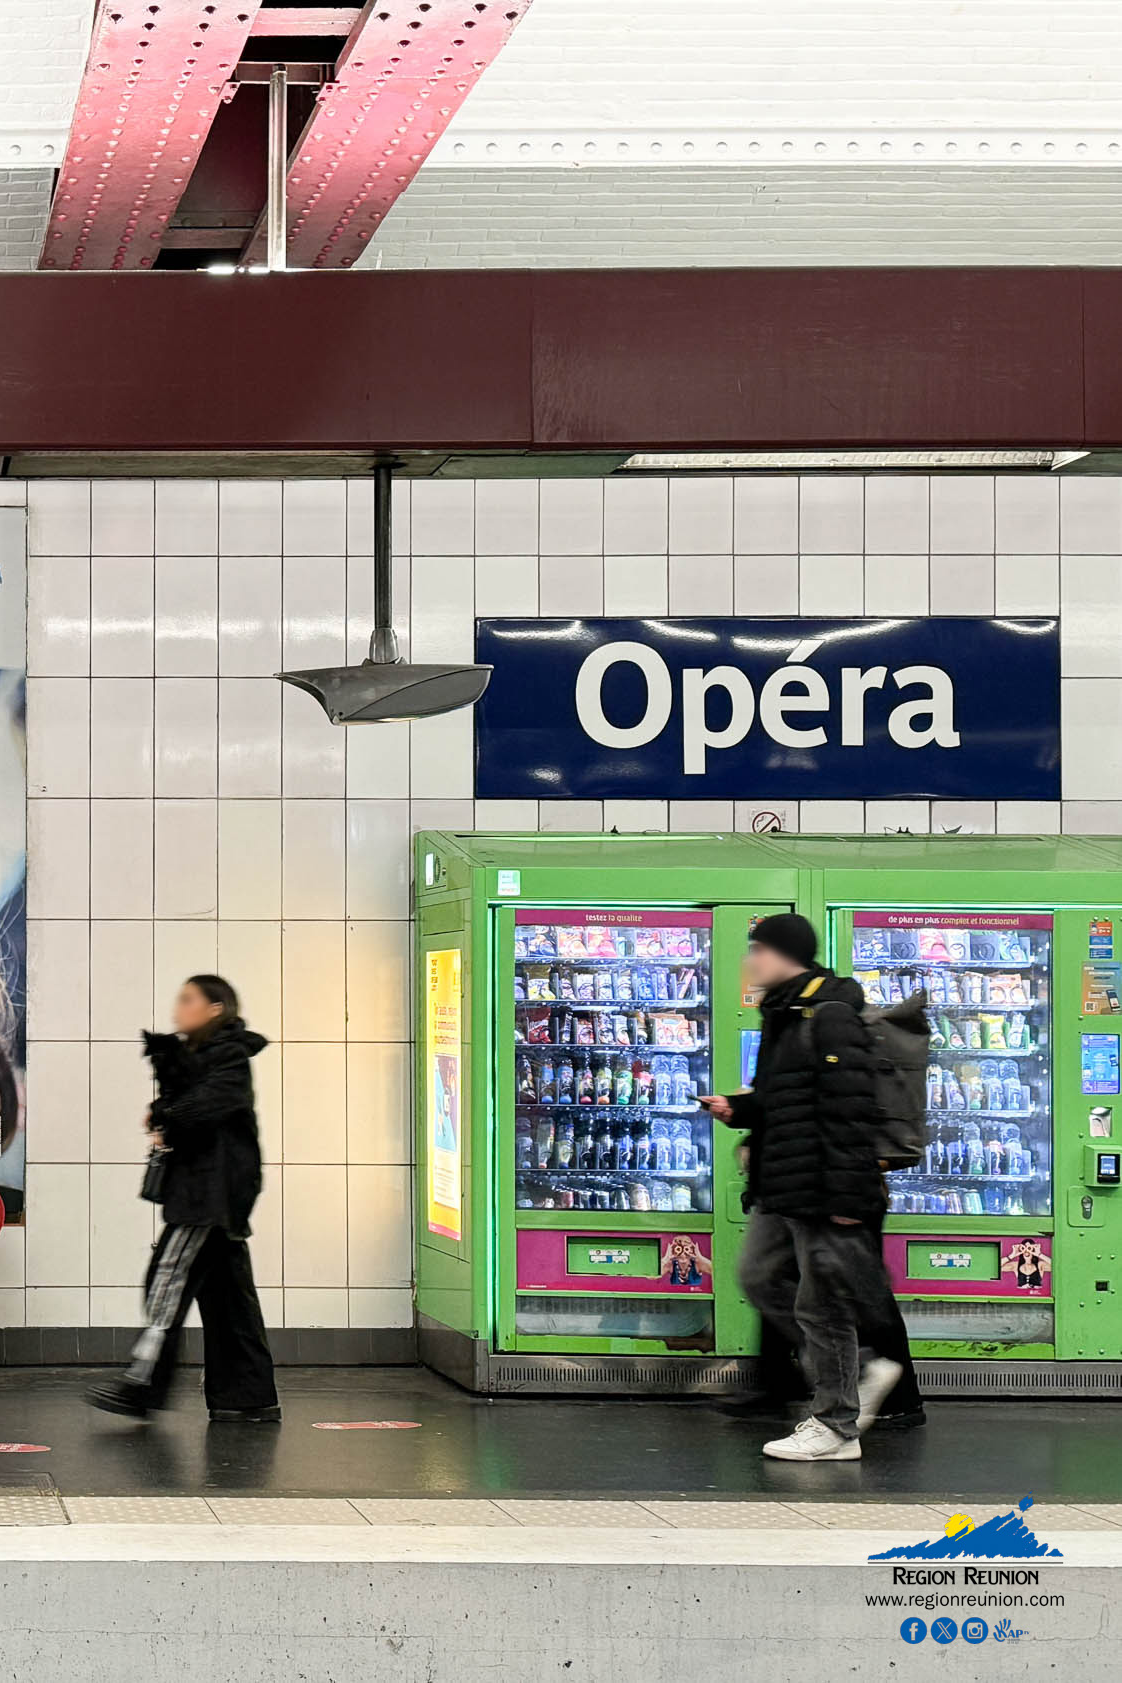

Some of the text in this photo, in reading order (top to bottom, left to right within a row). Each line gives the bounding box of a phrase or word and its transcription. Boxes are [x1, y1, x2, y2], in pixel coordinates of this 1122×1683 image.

[575, 639, 961, 775] Opéra
[585, 913, 607, 922] testez
[608, 914, 616, 922] la
[888, 915, 898, 924] de
[898, 915, 913, 925] plus
[924, 916, 940, 925] plus
